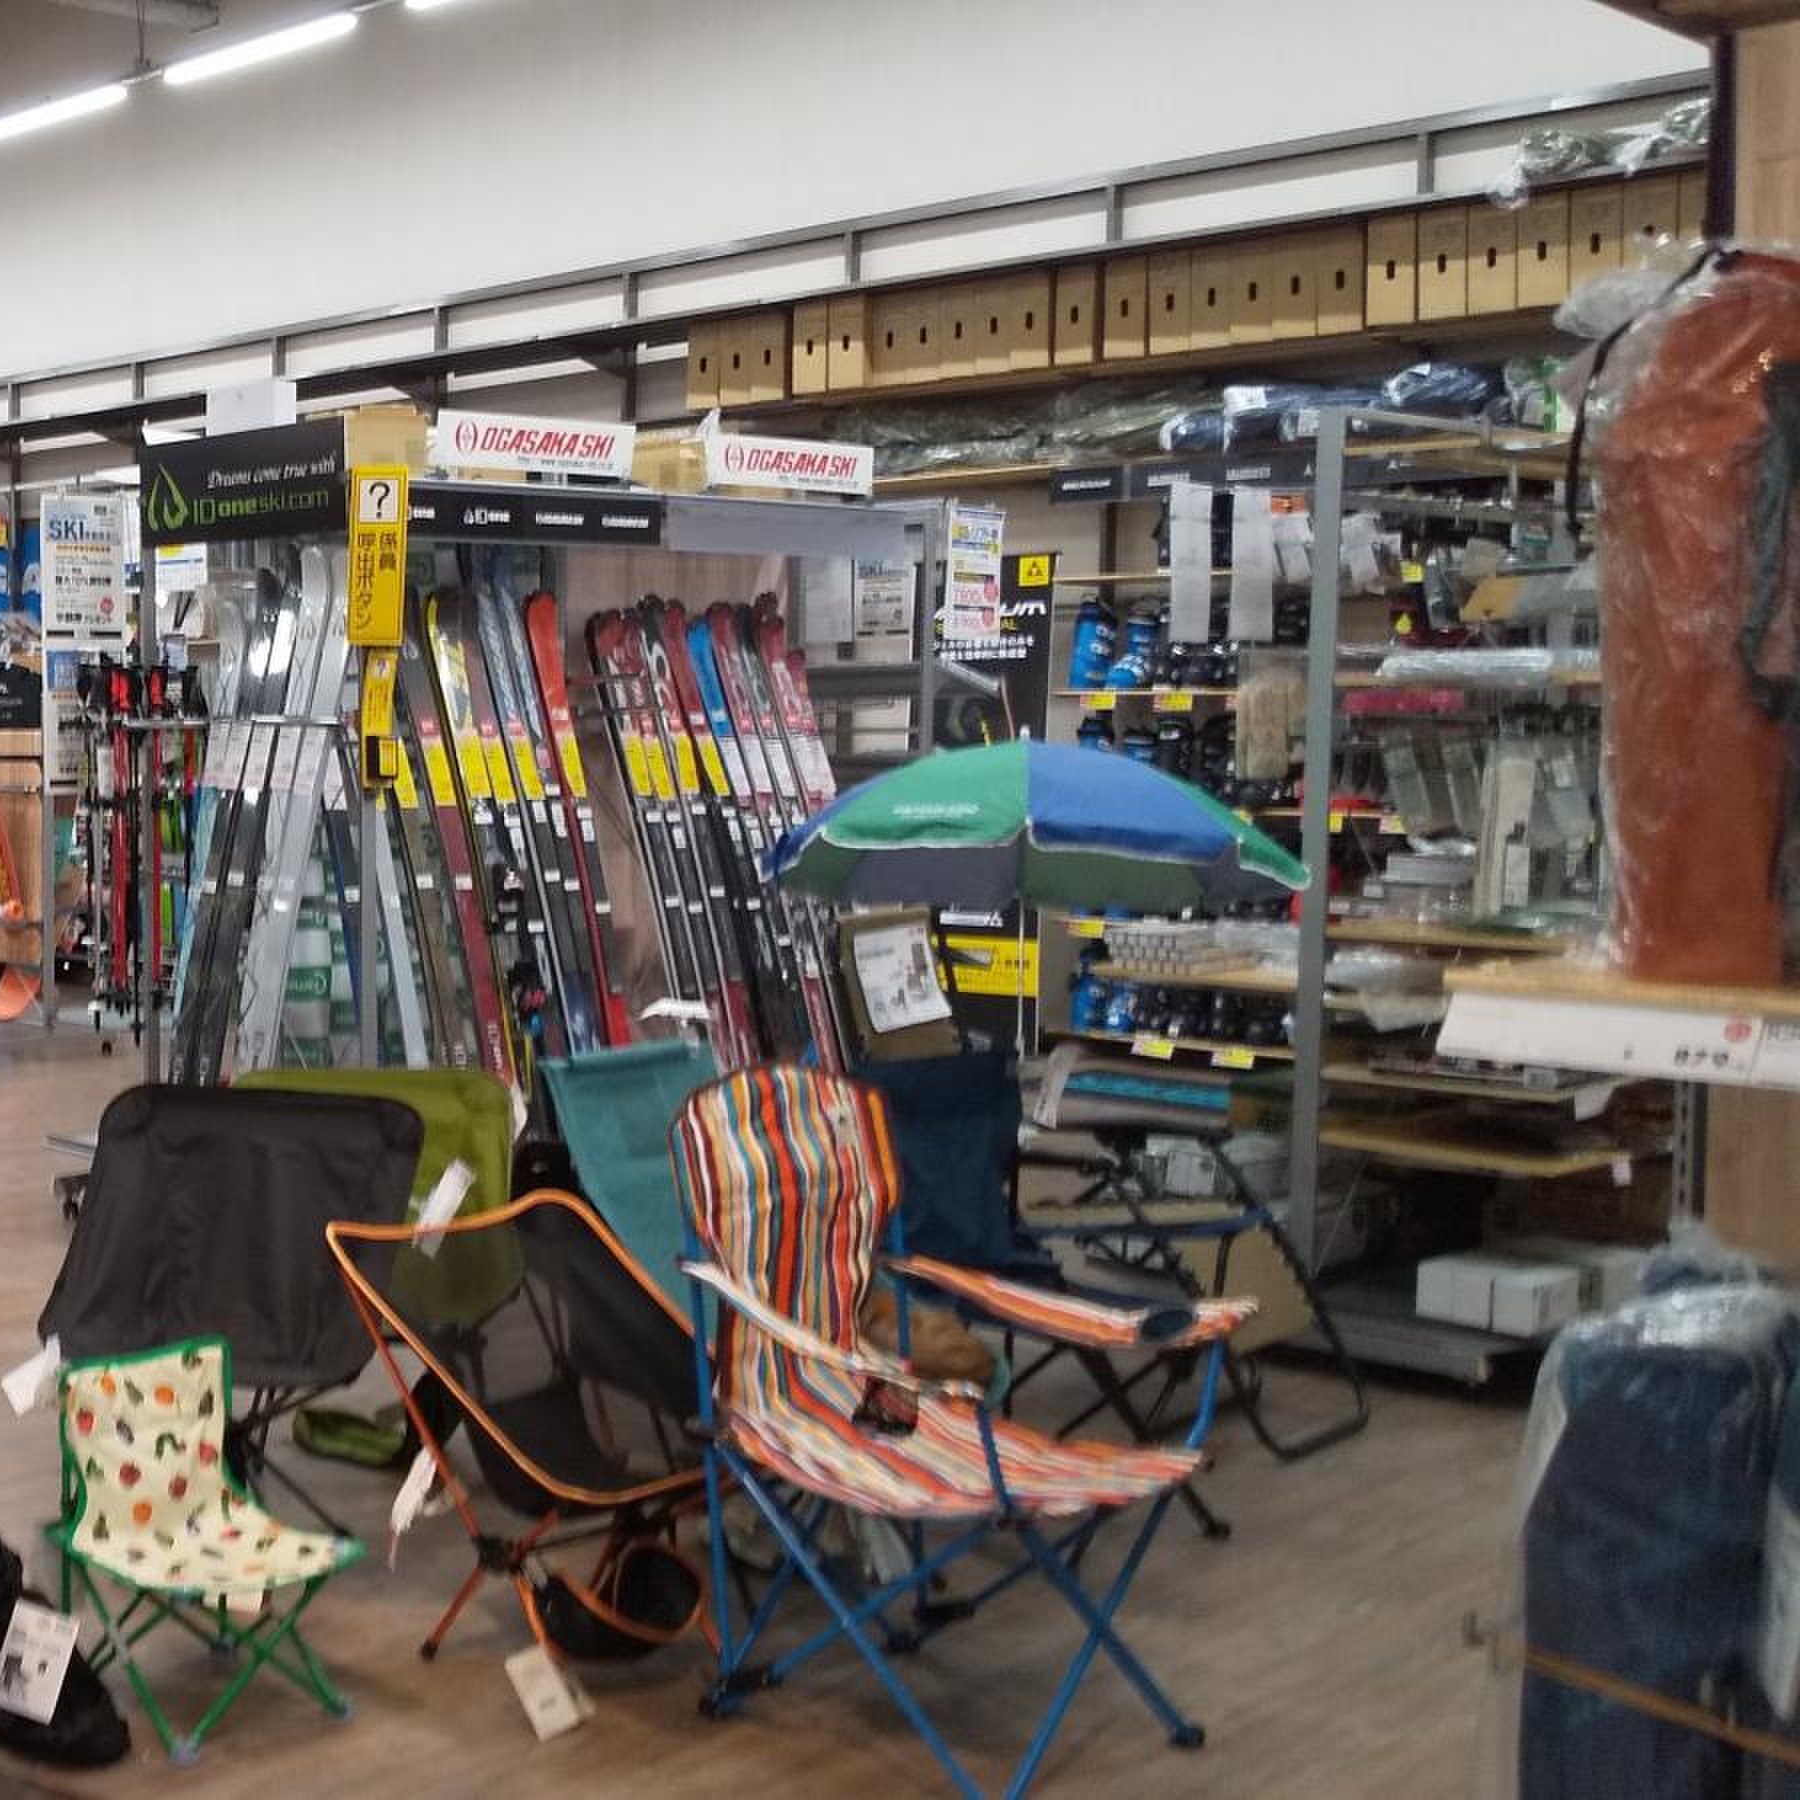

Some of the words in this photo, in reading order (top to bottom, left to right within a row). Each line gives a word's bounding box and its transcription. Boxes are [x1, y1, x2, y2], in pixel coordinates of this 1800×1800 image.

[480, 426, 580, 457] OGASAKA
[579, 434, 616, 460] SKI
[746, 448, 829, 476] OGASAKA
[828, 455, 857, 479] SKI
[49, 519, 85, 541] SKI
